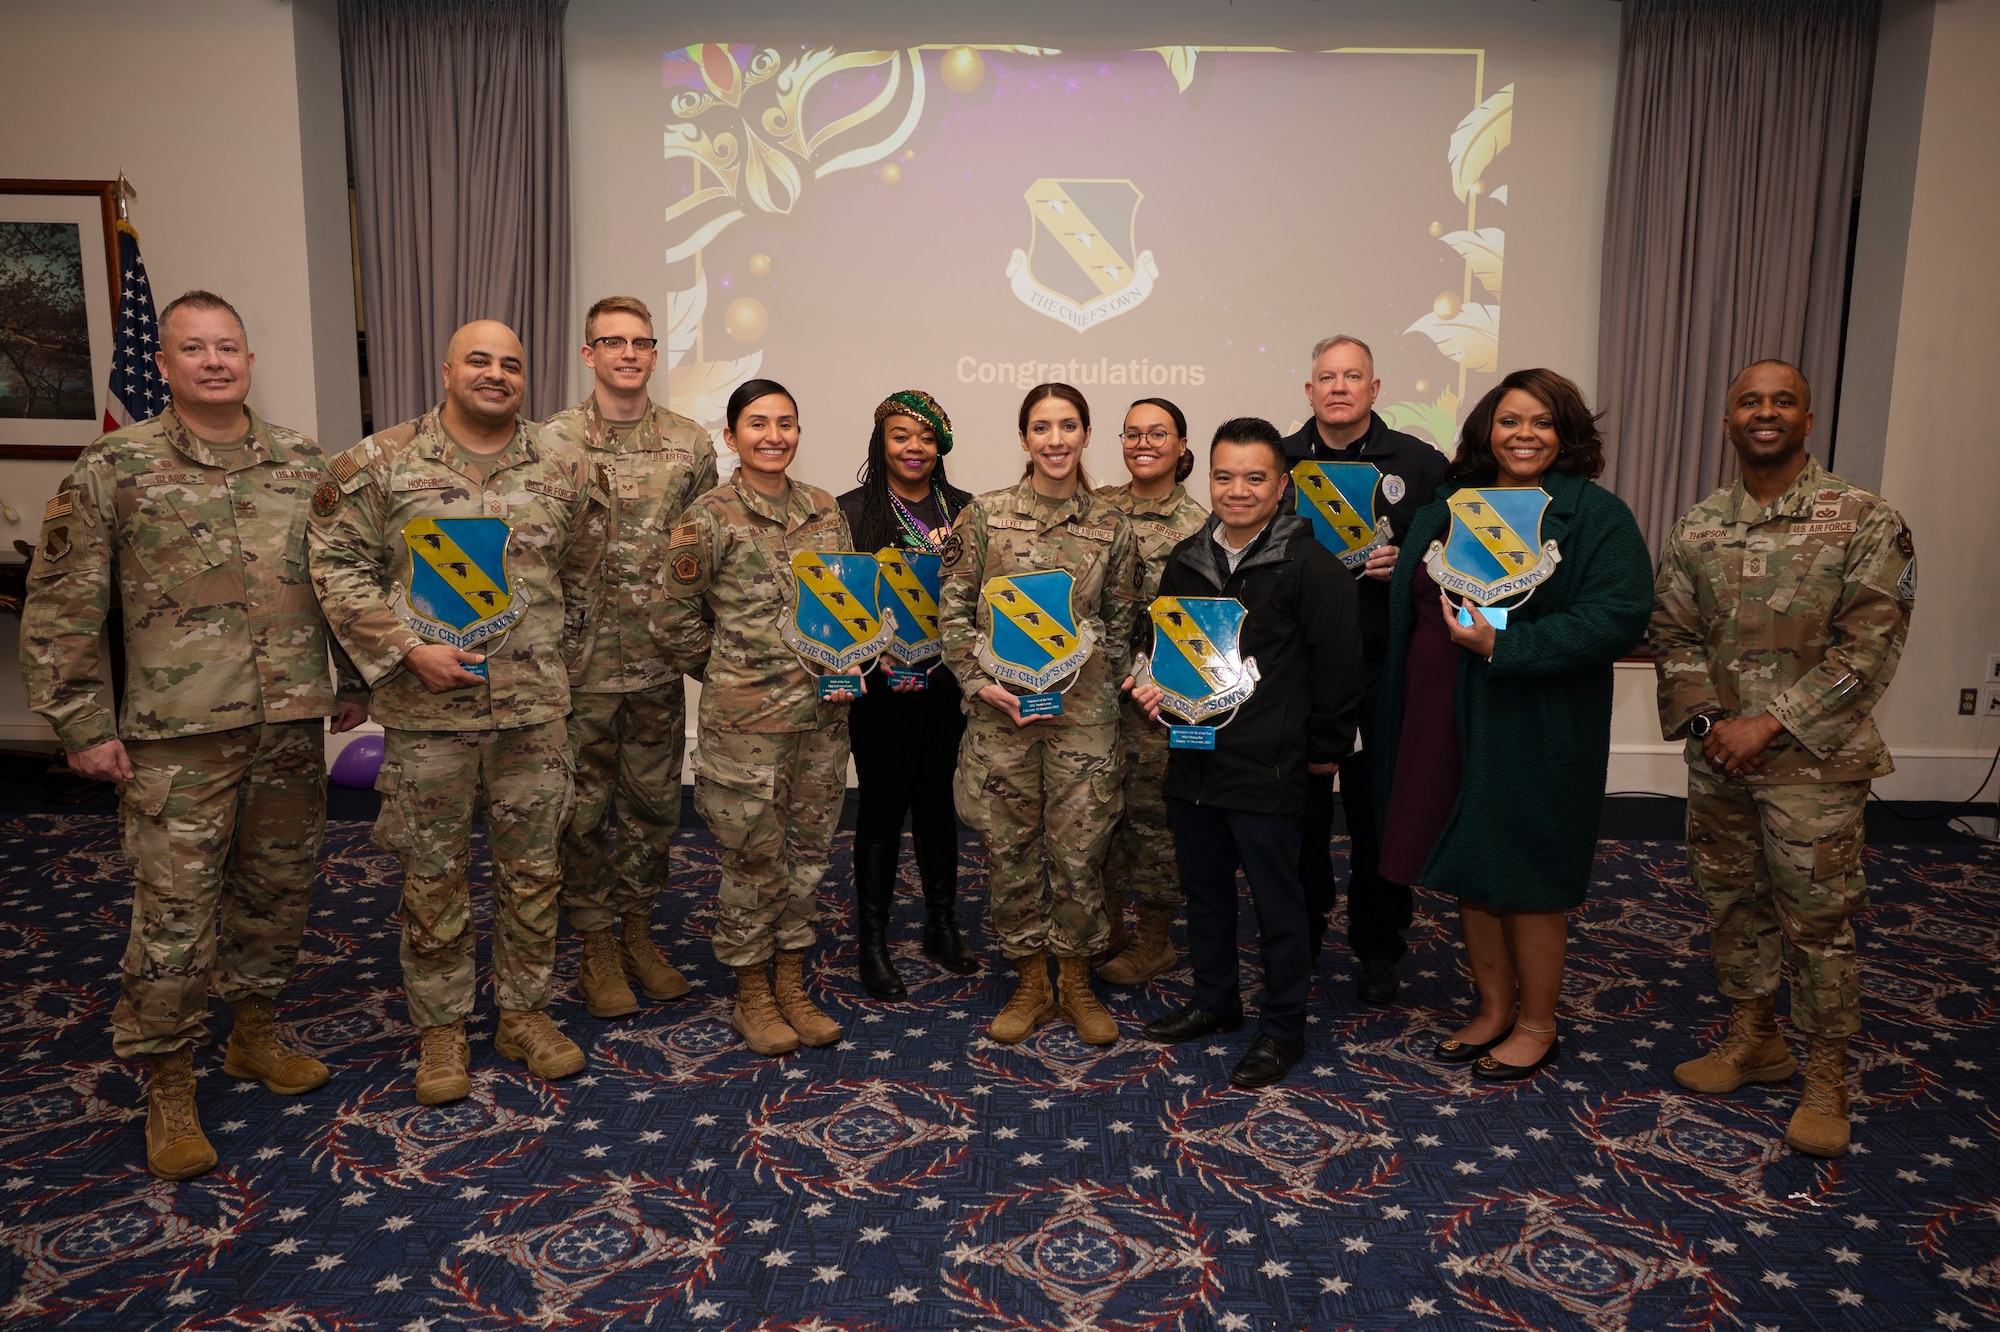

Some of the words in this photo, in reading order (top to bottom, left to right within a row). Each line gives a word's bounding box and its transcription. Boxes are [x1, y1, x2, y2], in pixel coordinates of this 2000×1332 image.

[1029, 290, 1056, 313] THE
[1059, 304, 1108, 328] CHIEF'S
[1110, 287, 1143, 311] OWN
[956, 355, 1206, 390] Congratulations
[407, 478, 438, 489] HOOPER
[1001, 519, 1023, 528] LEVEY
[1091, 529, 1112, 540] FORCE
[1689, 529, 1728, 540] THOMPSON
[1808, 524, 1823, 533] AIR
[1824, 521, 1852, 532] FORCE
[1441, 572, 1465, 589] THE
[1466, 581, 1512, 601] CHIEF'S
[1513, 570, 1544, 589] OWN
[410, 618, 437, 637] THE
[438, 627, 486, 649] CHIEF'S
[486, 611, 517, 634] OWN
[796, 639, 820, 658] THE
[820, 649, 861, 669] CHIEF'S
[861, 638, 885, 656] OWN
[892, 642, 930, 661] CHIEF'S
[994, 664, 1017, 680] THE
[1018, 666, 1060, 688] CHIEF'S
[1060, 651, 1085, 671] OWN
[1217, 687, 1246, 709] OWN
